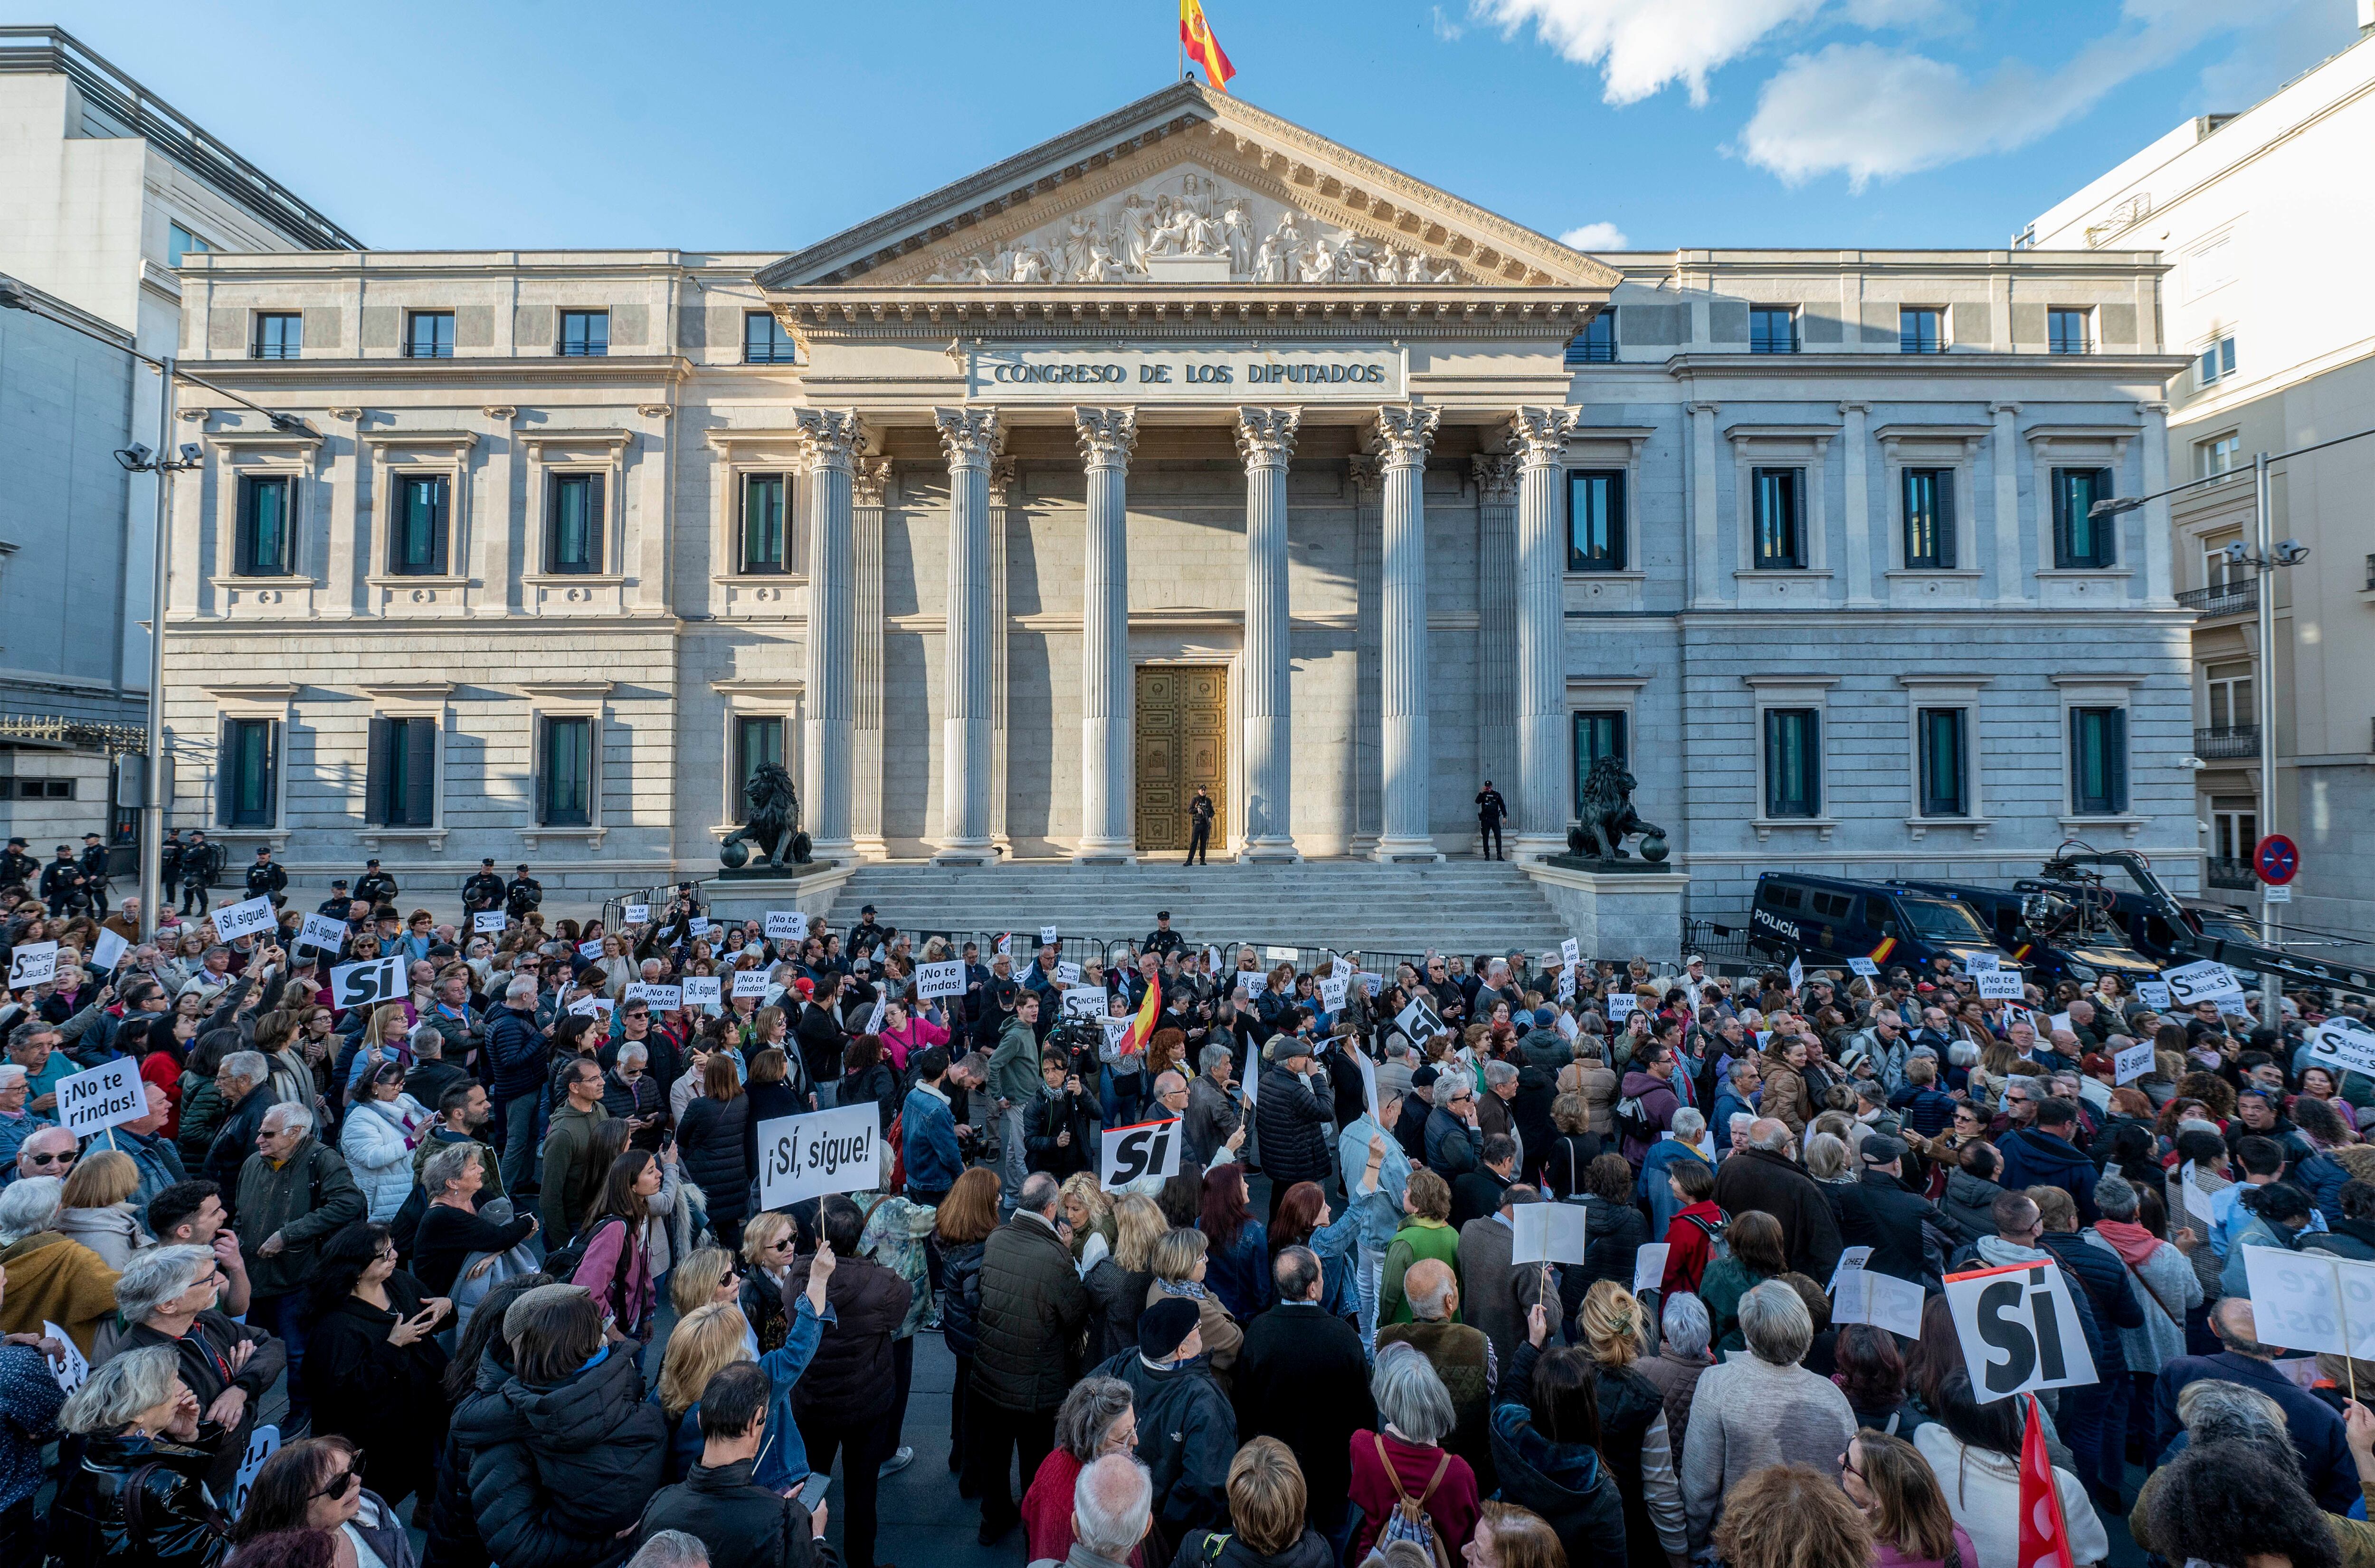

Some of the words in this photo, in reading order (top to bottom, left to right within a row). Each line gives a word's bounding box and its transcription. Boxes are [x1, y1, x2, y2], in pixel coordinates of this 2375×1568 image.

[994, 364, 1121, 383] CONGRESO
[1139, 364, 1167, 383] DE
[1185, 364, 1229, 383] LOS
[1248, 364, 1380, 383] DIPUTADOS
[220, 909, 236, 934] ¡SÍ,
[238, 905, 268, 925] sigue!
[769, 915, 785, 924] ¡No
[788, 916, 798, 924] te
[1755, 908, 1800, 941] POLICÍA
[304, 919, 319, 937] ¡SÍ,
[319, 926, 341, 942] sigue!
[768, 925, 800, 934] rindas!
[584, 948, 603, 957] rindas
[920, 969, 940, 982] ¡No
[944, 967, 956, 976] te
[1341, 965, 1348, 974] te
[738, 975, 753, 983] ¡No
[922, 979, 960, 992] rindas!
[1251, 979, 1267, 992] sigue
[1982, 976, 2000, 985] ¡No
[645, 989, 663, 997] ¡No
[685, 980, 697, 998] ¡SÍ,
[699, 983, 718, 998] sigue!
[1324, 984, 1332, 997] ¡No
[1334, 983, 1340, 992] te
[1612, 998, 1624, 1008] ¡No
[1612, 1008, 1628, 1016] rind
[1111, 1025, 1126, 1038] ¡No
[2317, 1032, 2375, 1055] SÁNCH
[65, 1080, 98, 1108] ¡No
[103, 1073, 123, 1091] te
[69, 1091, 136, 1127] rindas!
[767, 1126, 801, 1187] ¡SÍ,
[808, 1126, 872, 1175] sigue!
